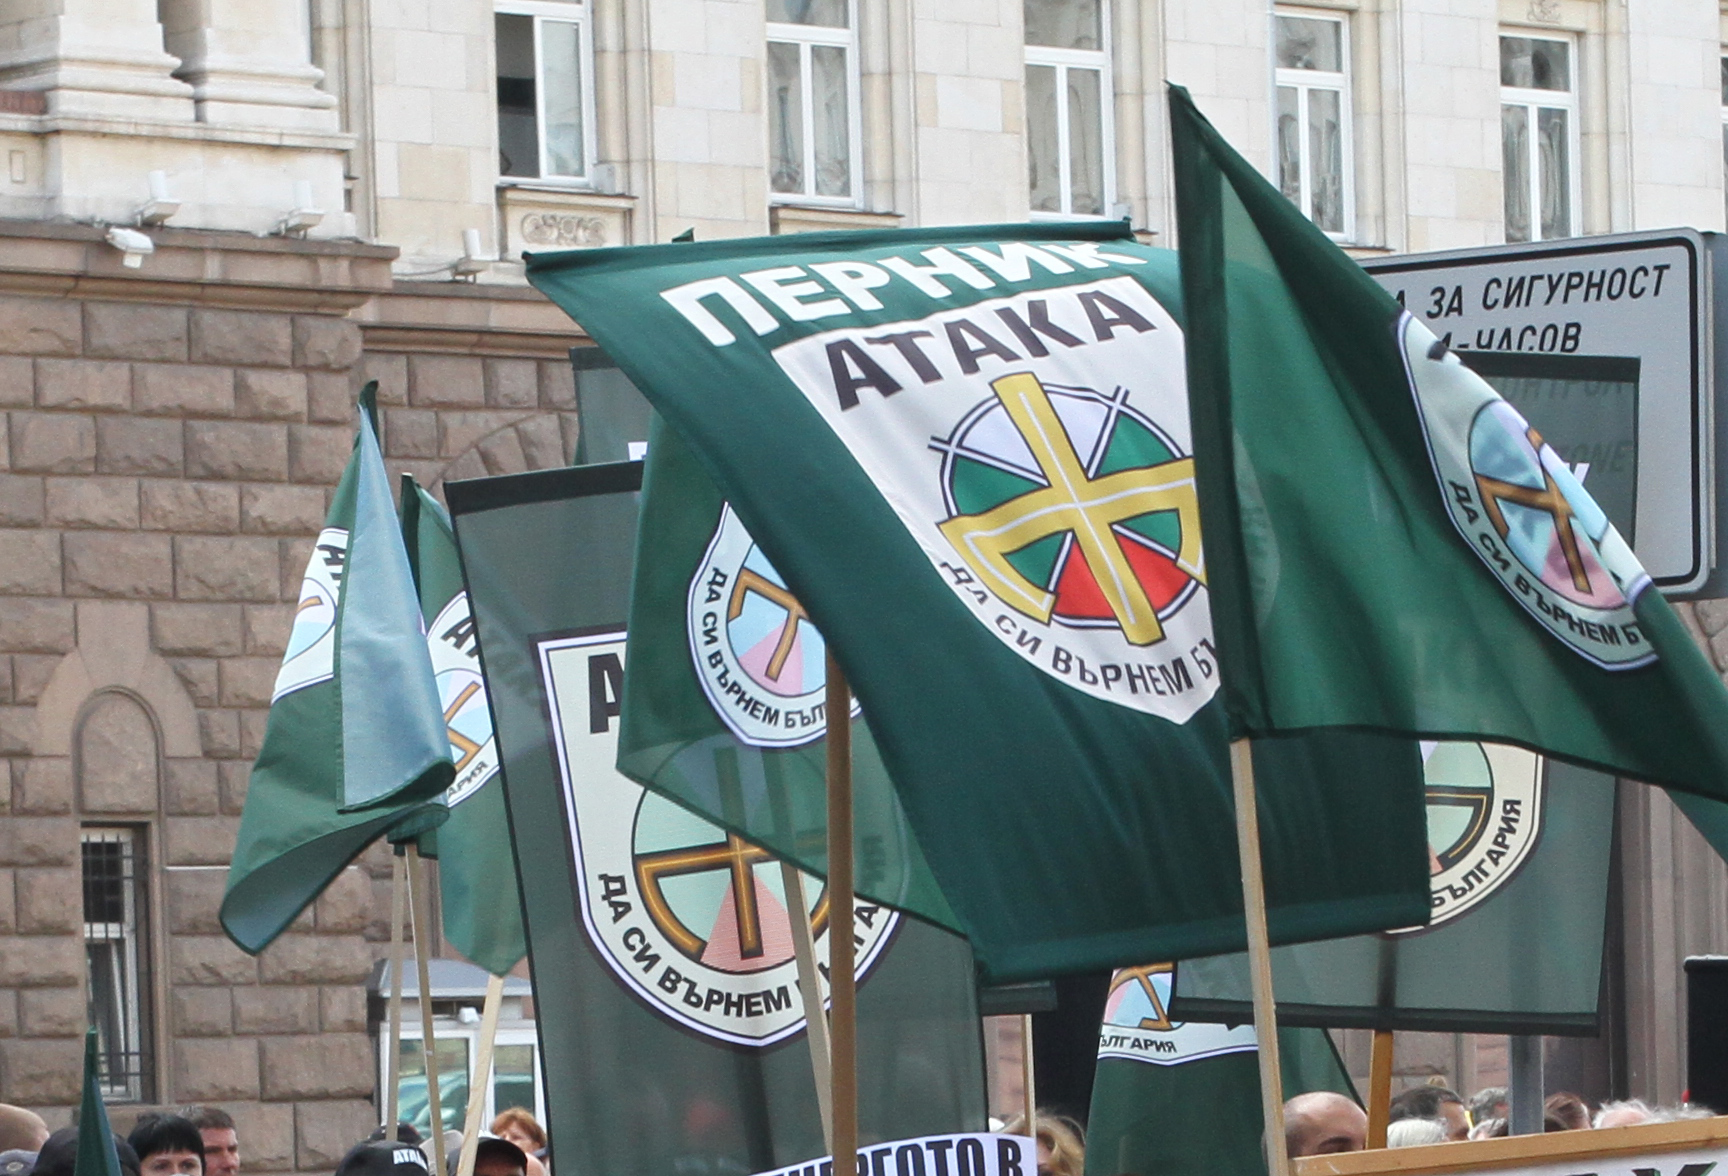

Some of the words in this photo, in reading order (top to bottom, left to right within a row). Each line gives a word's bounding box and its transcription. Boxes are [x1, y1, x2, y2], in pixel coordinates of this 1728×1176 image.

[660, 241, 1147, 347] ПЕРНИК
[1426, 285, 1463, 319] ЗА
[1482, 264, 1671, 311] СИГУРНОСТ
[825, 290, 1157, 412] АТАКА
[704, 567, 728, 604] ДА
[1449, 481, 1479, 525] ДА
[1480, 533, 1511, 571] СИ
[1515, 578, 1622, 646] ВЪРНЕМ
[702, 612, 718, 646] СИ
[996, 614, 1042, 655] СИ
[1052, 646, 1194, 696] ВЪРНЕМ
[707, 649, 780, 727] ВЪРНЕМ
[598, 873, 632, 923] ДА
[622, 927, 661, 974] СИ
[657, 966, 792, 1018] ВЪРНЕМ
